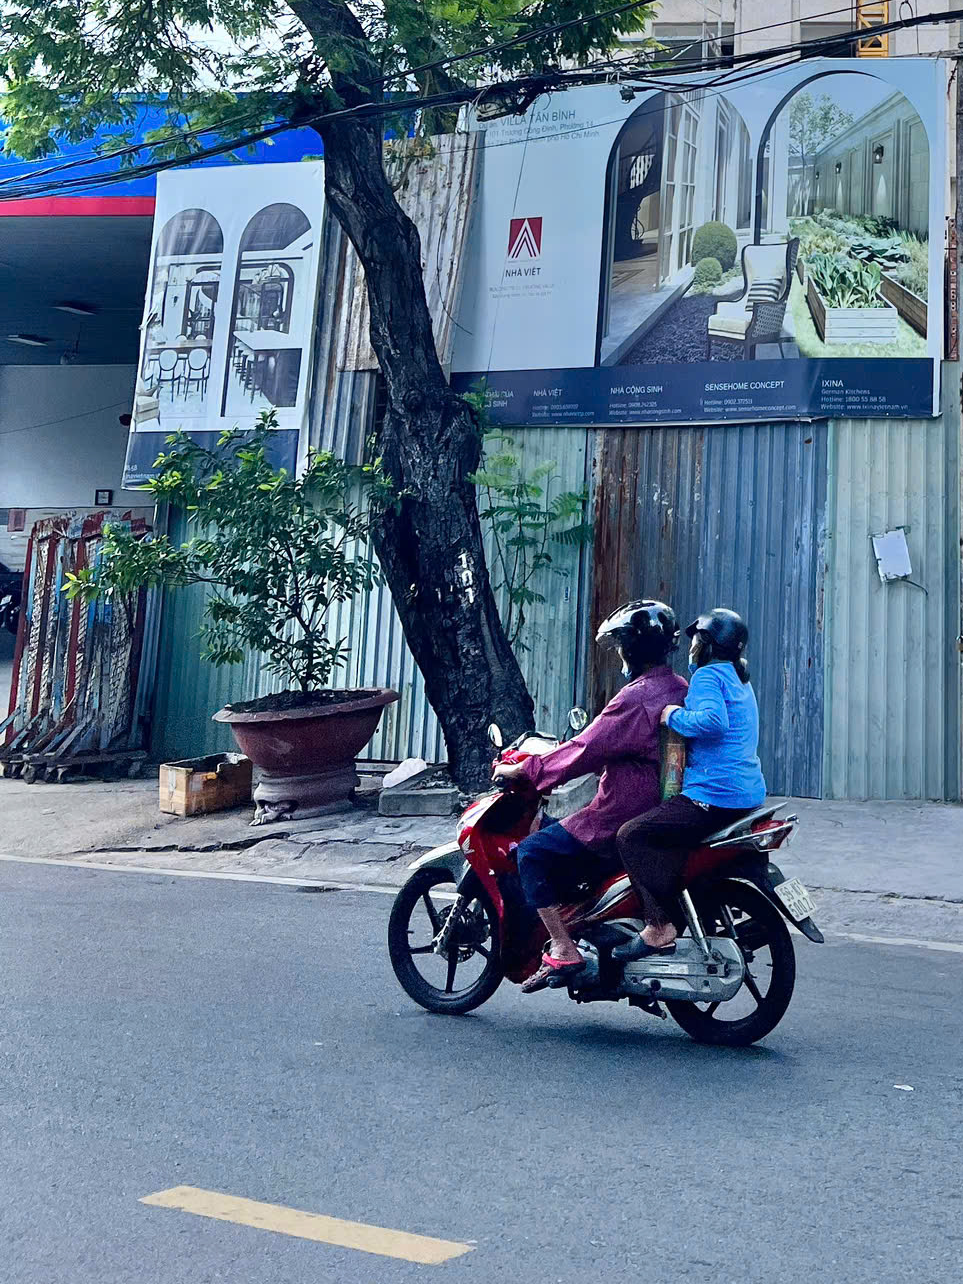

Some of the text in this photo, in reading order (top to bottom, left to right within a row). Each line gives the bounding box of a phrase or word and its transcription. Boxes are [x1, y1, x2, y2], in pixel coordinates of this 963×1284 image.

[500, 117, 527, 127] VILLA
[551, 108, 576, 122] BÌNH
[505, 268, 523, 278] NHÀ
[704, 380, 785, 392] SENSEHOME CONCEPT
[821, 379, 844, 388] IXINA
[533, 388, 547, 397] NHÀ
[610, 384, 663, 395] NHÀ CỘNG SINH
